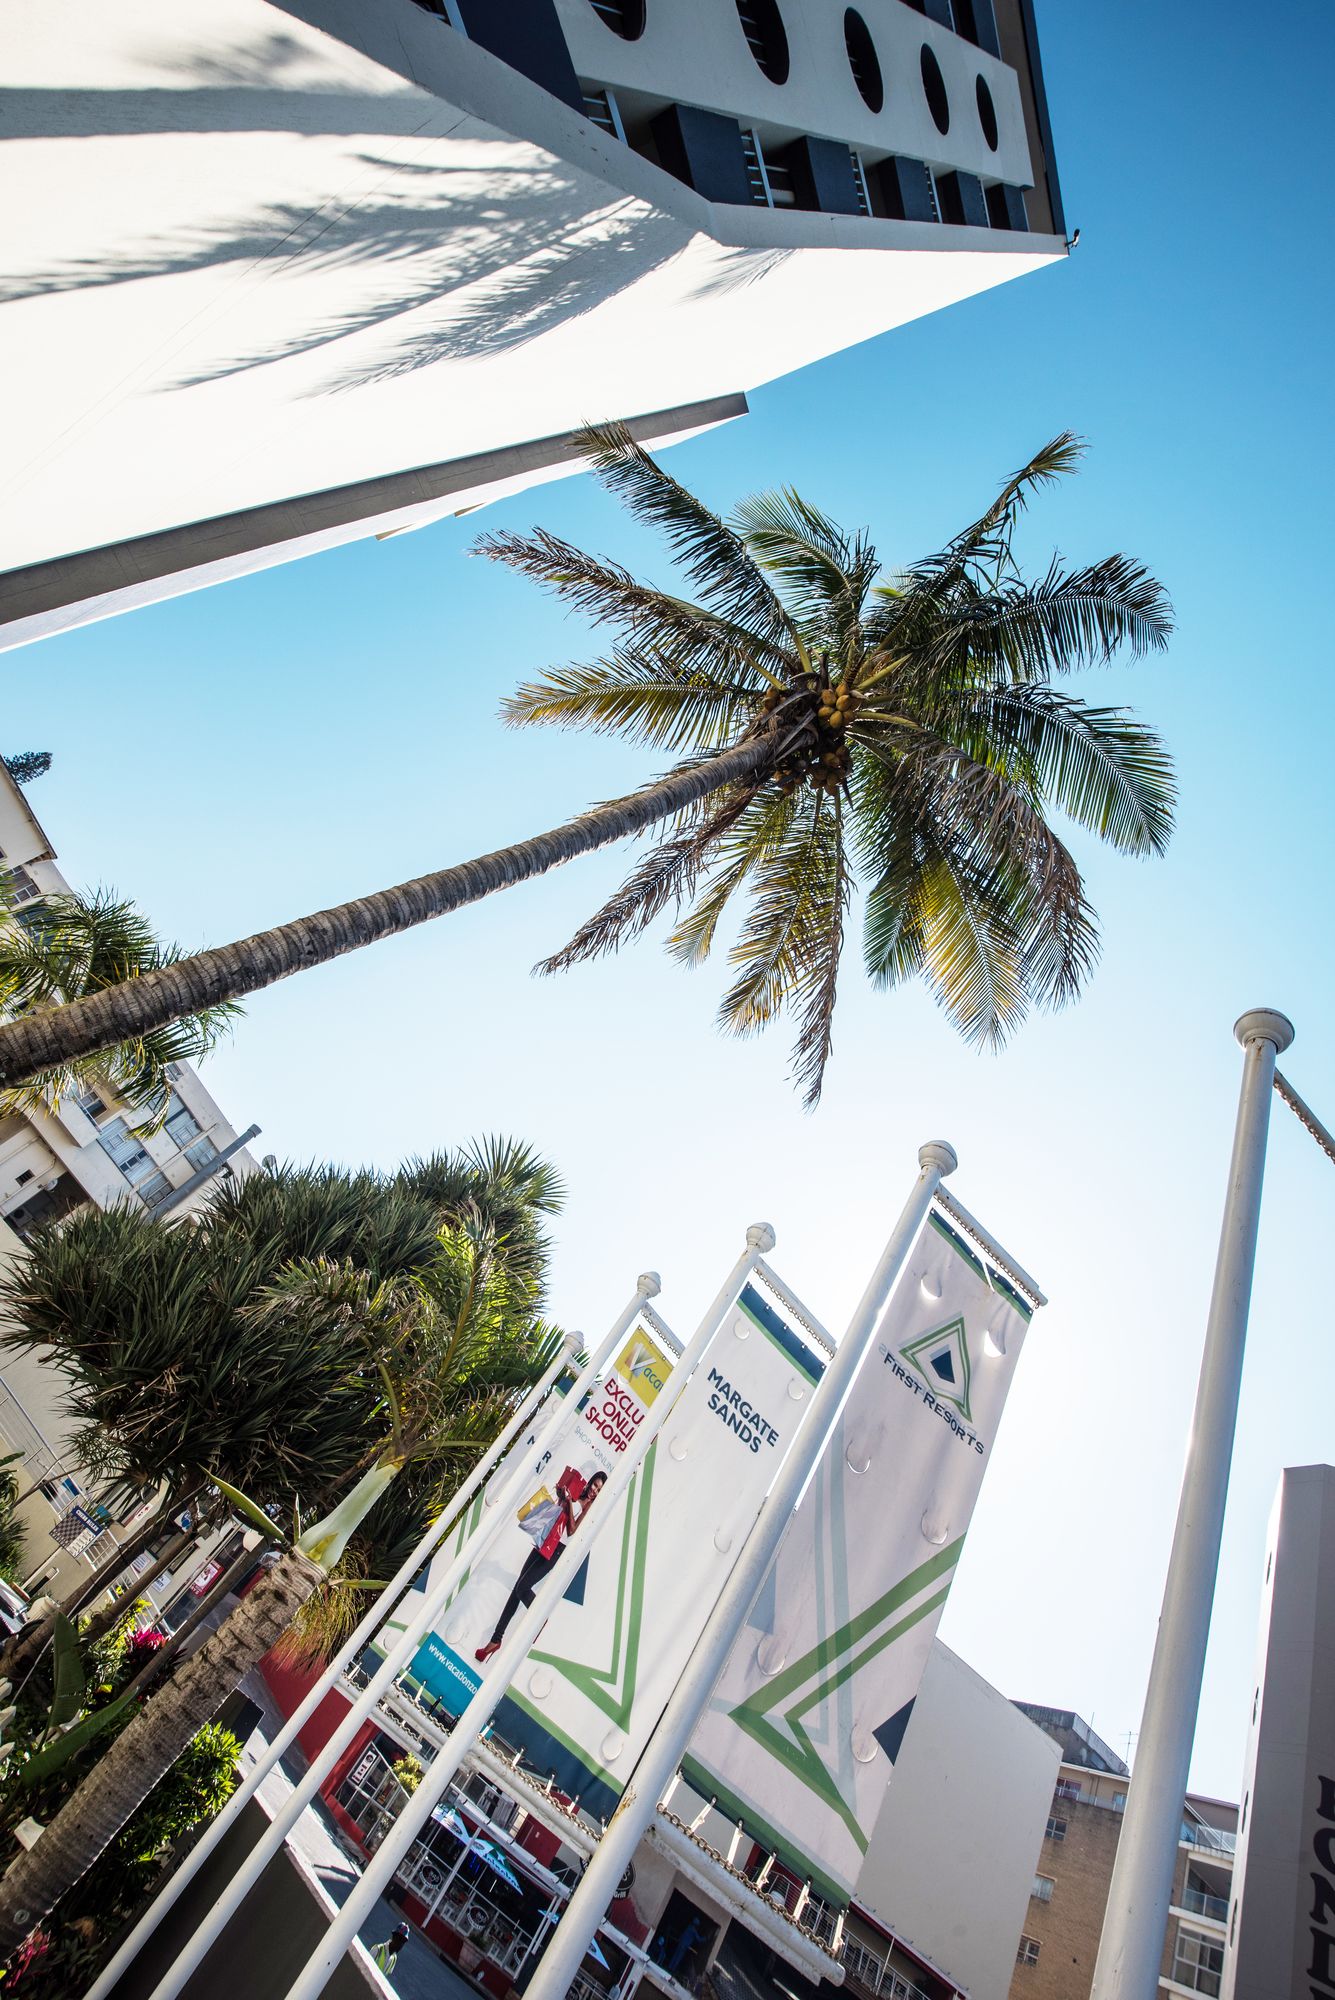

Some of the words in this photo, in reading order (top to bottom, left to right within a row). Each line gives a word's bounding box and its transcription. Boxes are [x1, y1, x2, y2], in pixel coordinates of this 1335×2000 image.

[585, 1406, 627, 1453] SHOPP
[707, 1367, 779, 1447] MARGATE
[707, 1393, 762, 1453] SANDS
[884, 1352, 922, 1394] FIRST
[923, 1392, 985, 1455] RESORTS
